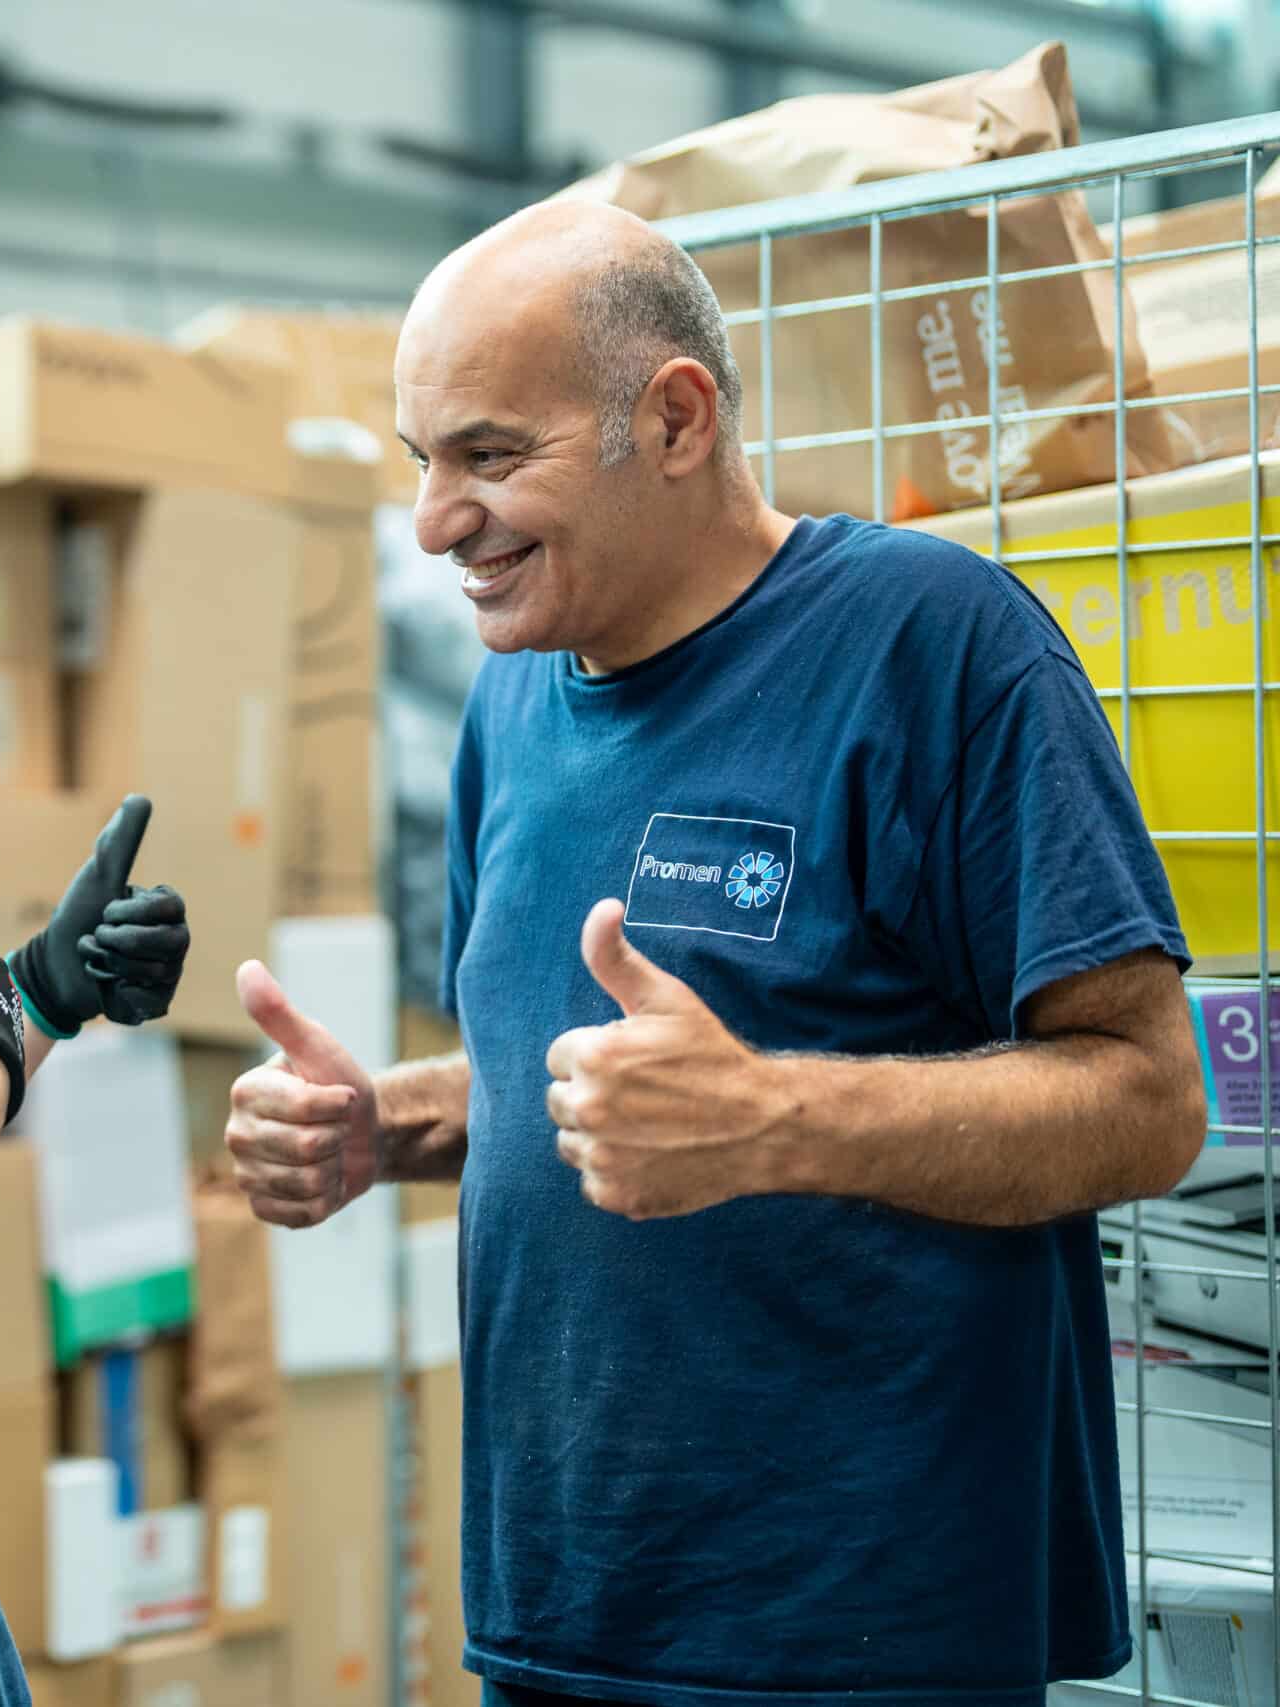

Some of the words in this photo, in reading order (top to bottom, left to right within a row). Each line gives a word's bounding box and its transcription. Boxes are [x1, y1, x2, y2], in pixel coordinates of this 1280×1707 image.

[917, 299, 965, 393] me.
[935, 399, 988, 497] ove
[640, 855, 721, 882] Promen
[1219, 1005, 1259, 1063] 3
